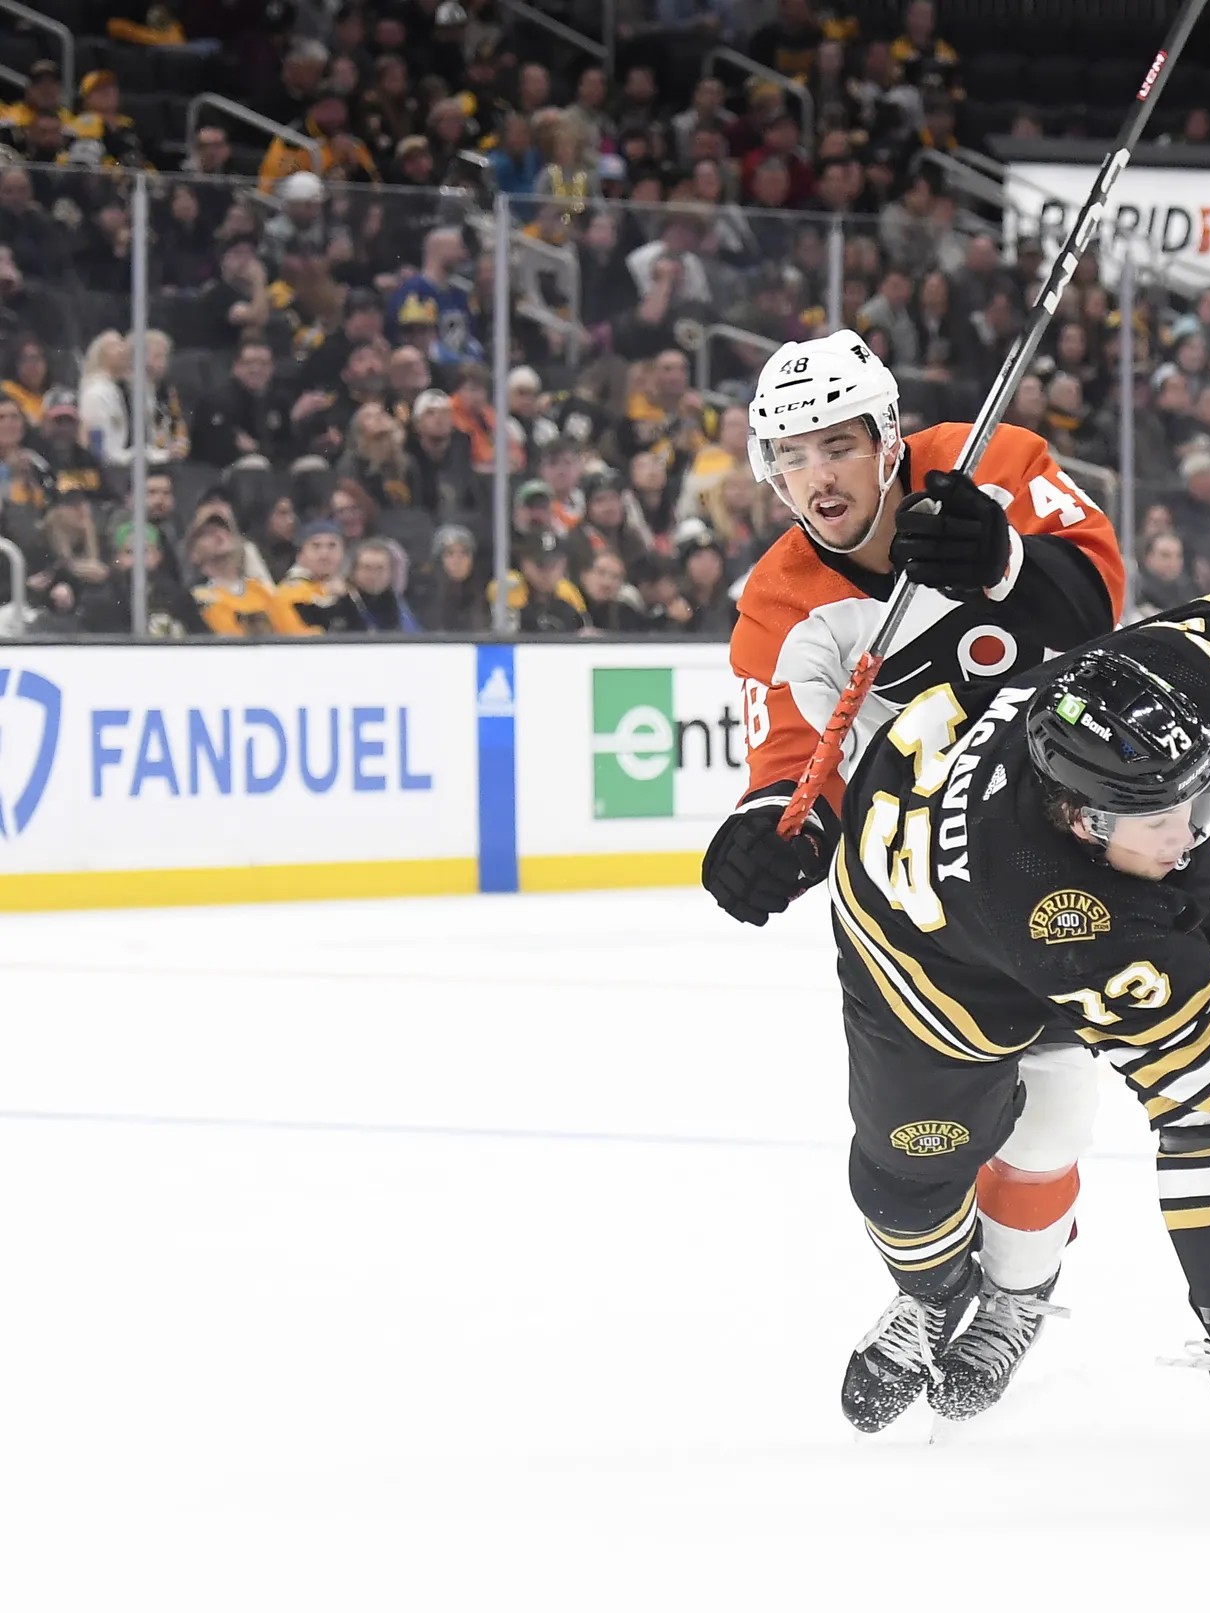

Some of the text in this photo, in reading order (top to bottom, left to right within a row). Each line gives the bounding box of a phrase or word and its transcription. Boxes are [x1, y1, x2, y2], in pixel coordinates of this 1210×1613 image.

[780, 356, 810, 375] 48
[774, 398, 817, 415] CCM
[744, 677, 771, 750] 8
[1080, 712, 1113, 742] Bank
[90, 706, 433, 798] FANDUEL
[1158, 726, 1193, 760] 73
[1034, 893, 1104, 927] BRUINS
[1056, 913, 1080, 928] 100
[1047, 960, 1172, 1026] 73
[895, 1123, 963, 1144] BRUINS
[919, 1136, 942, 1147] 100
